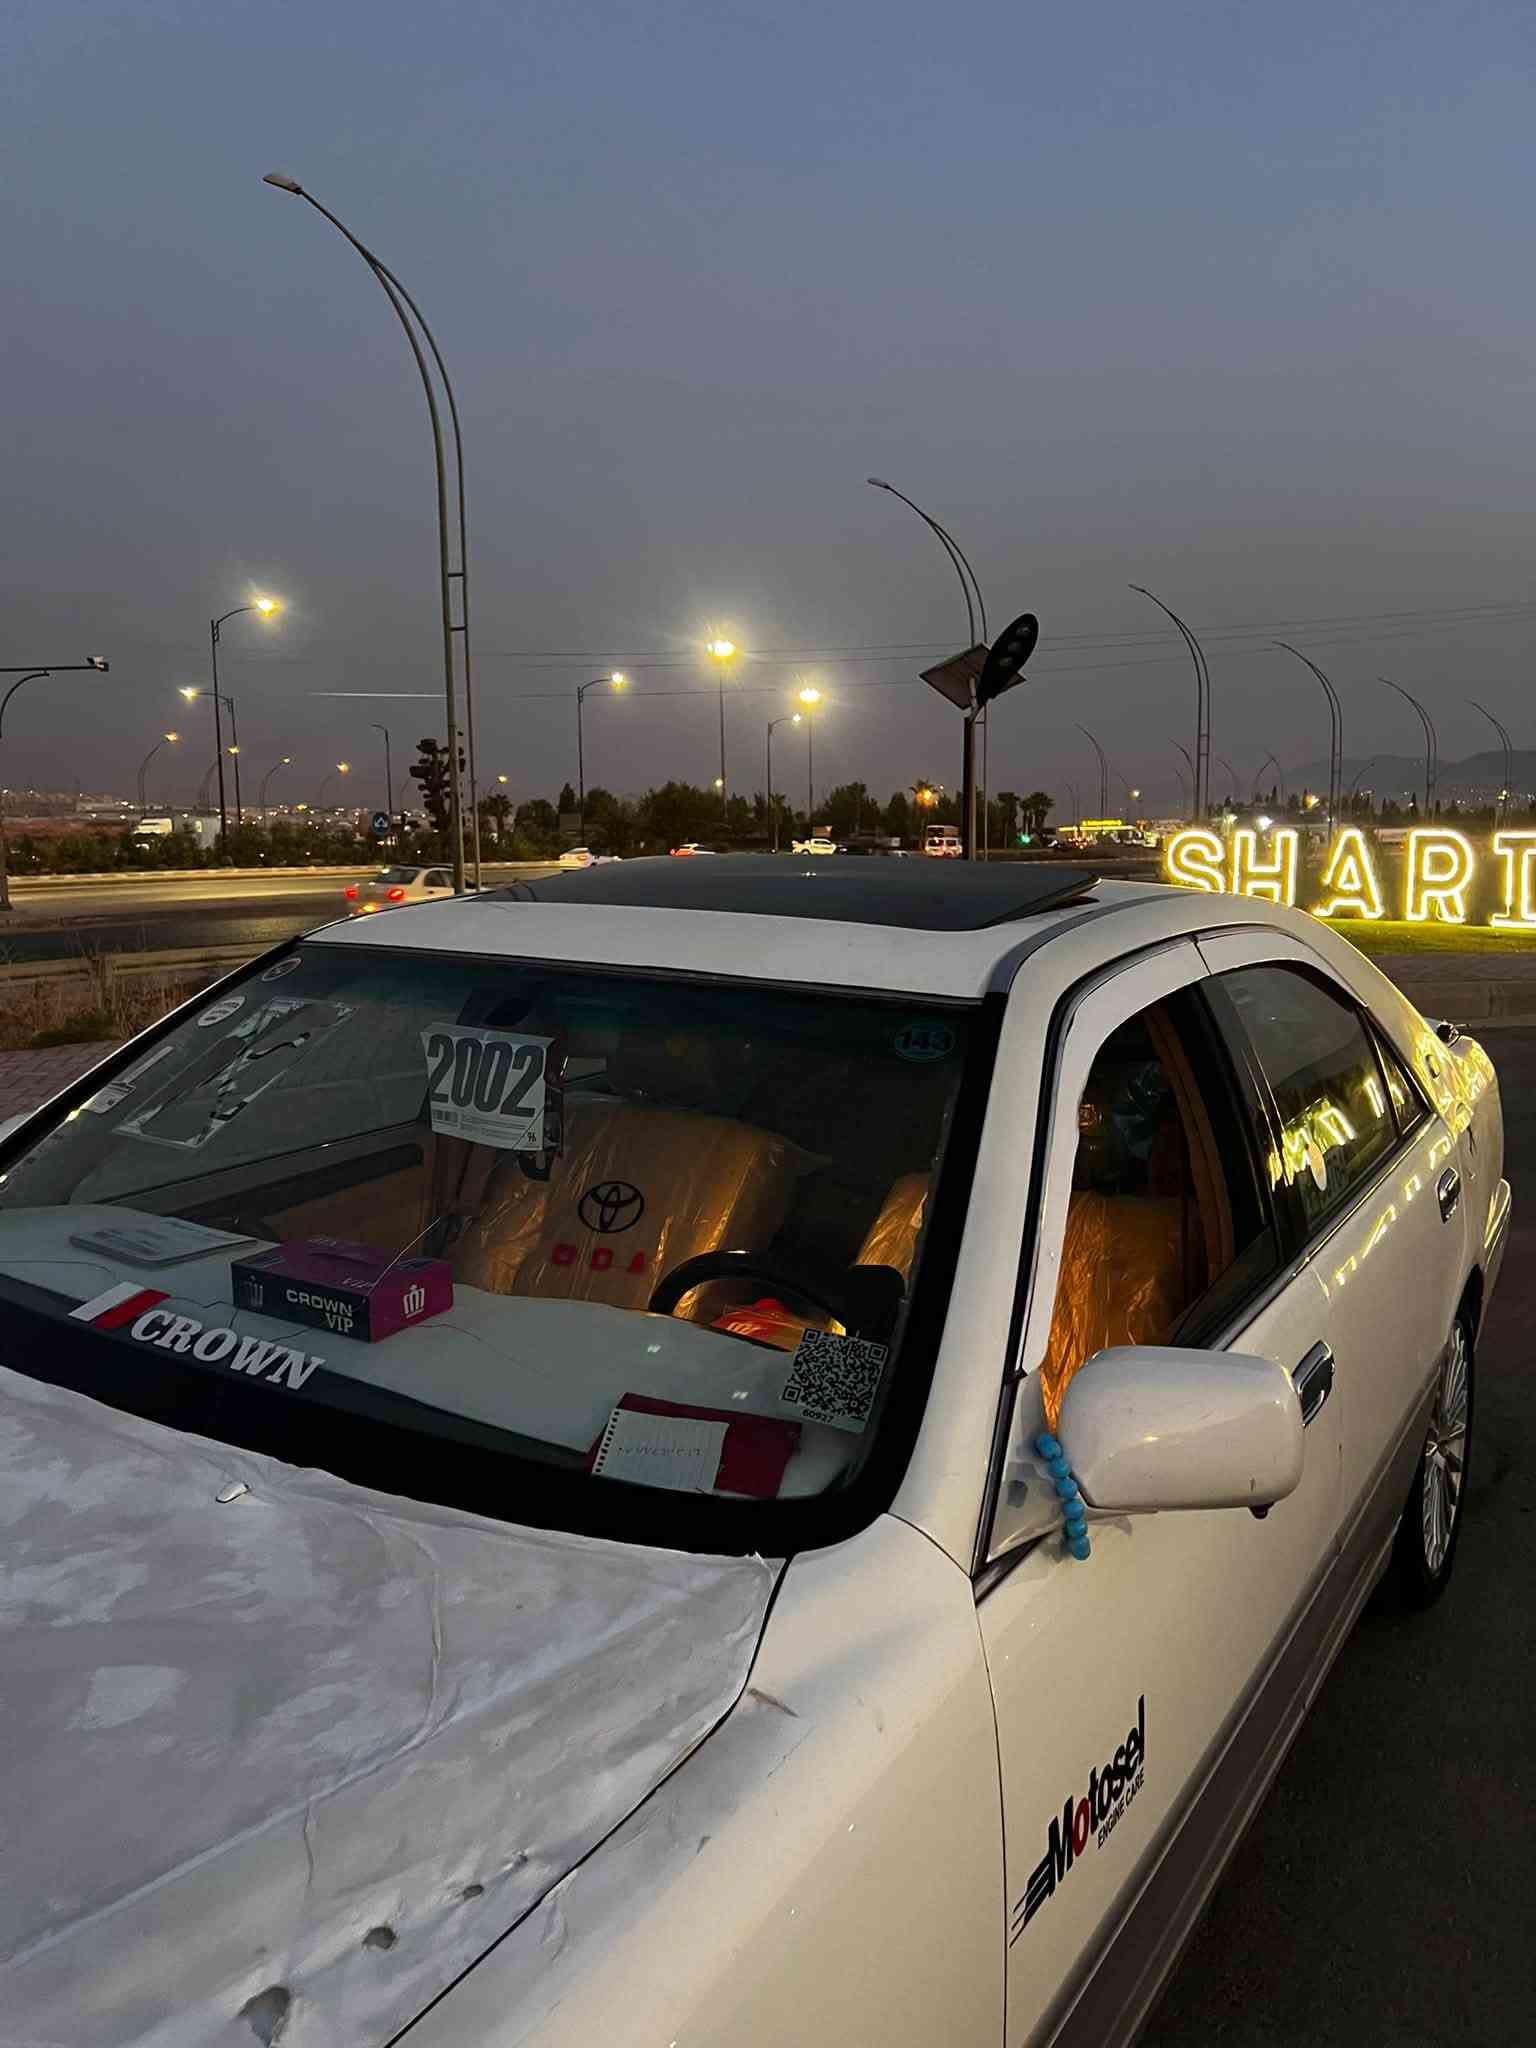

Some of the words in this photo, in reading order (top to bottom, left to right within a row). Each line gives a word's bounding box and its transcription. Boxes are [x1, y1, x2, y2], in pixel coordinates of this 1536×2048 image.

[427, 1033, 545, 1118] 2002
[285, 1288, 354, 1318] CROWN
[325, 1312, 354, 1334] VIP
[130, 1310, 326, 1391] CROWN
[1097, 1797, 1125, 1849] ENGINE
[1125, 1767, 1145, 1807] CARE
